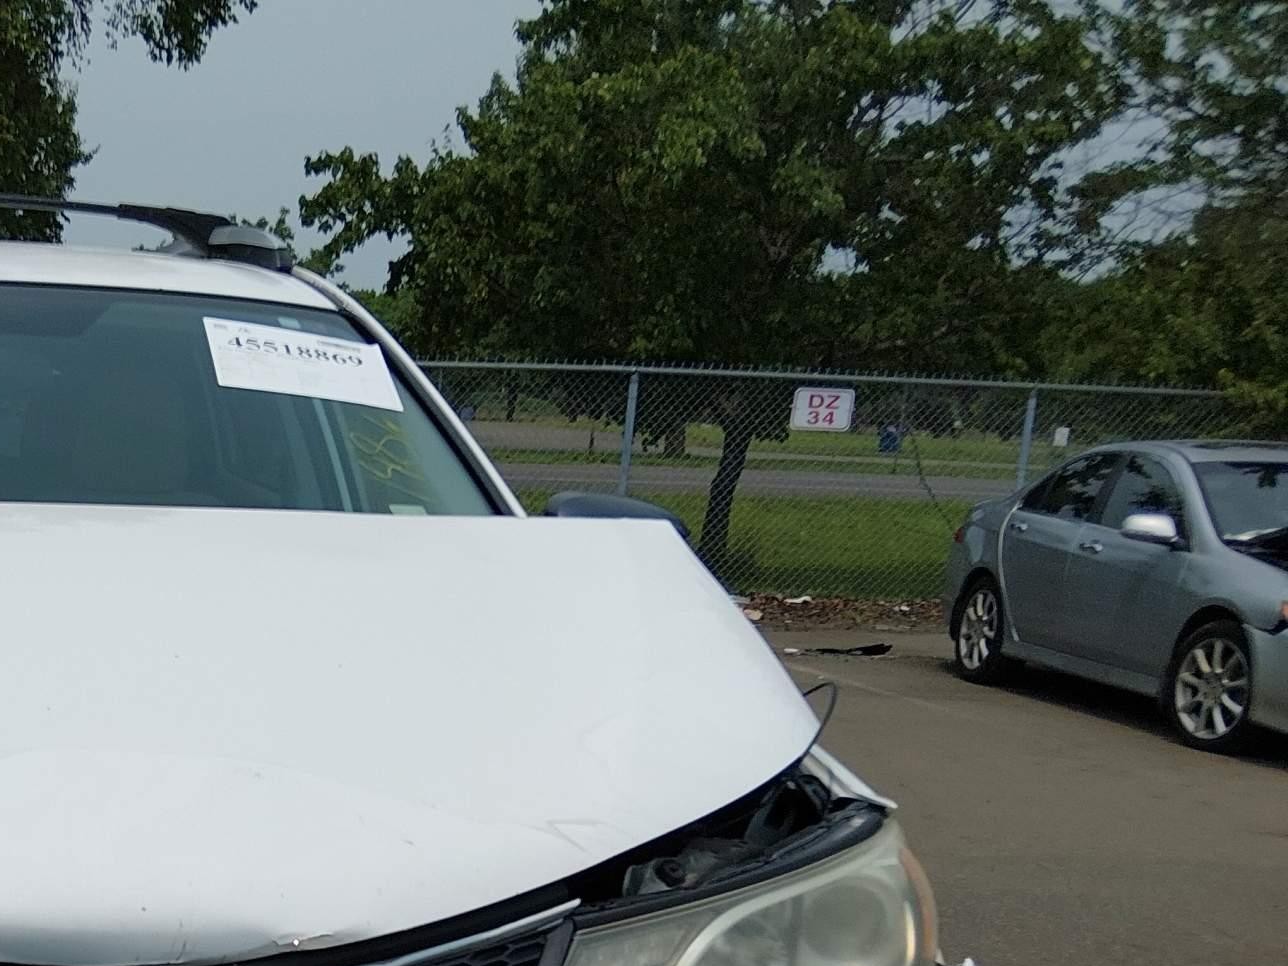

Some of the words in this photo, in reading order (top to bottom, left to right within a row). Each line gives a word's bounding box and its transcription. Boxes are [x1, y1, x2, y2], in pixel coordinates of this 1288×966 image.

[228, 336, 363, 368] 45518869
[808, 394, 841, 410] DZ
[807, 410, 835, 425] 34
